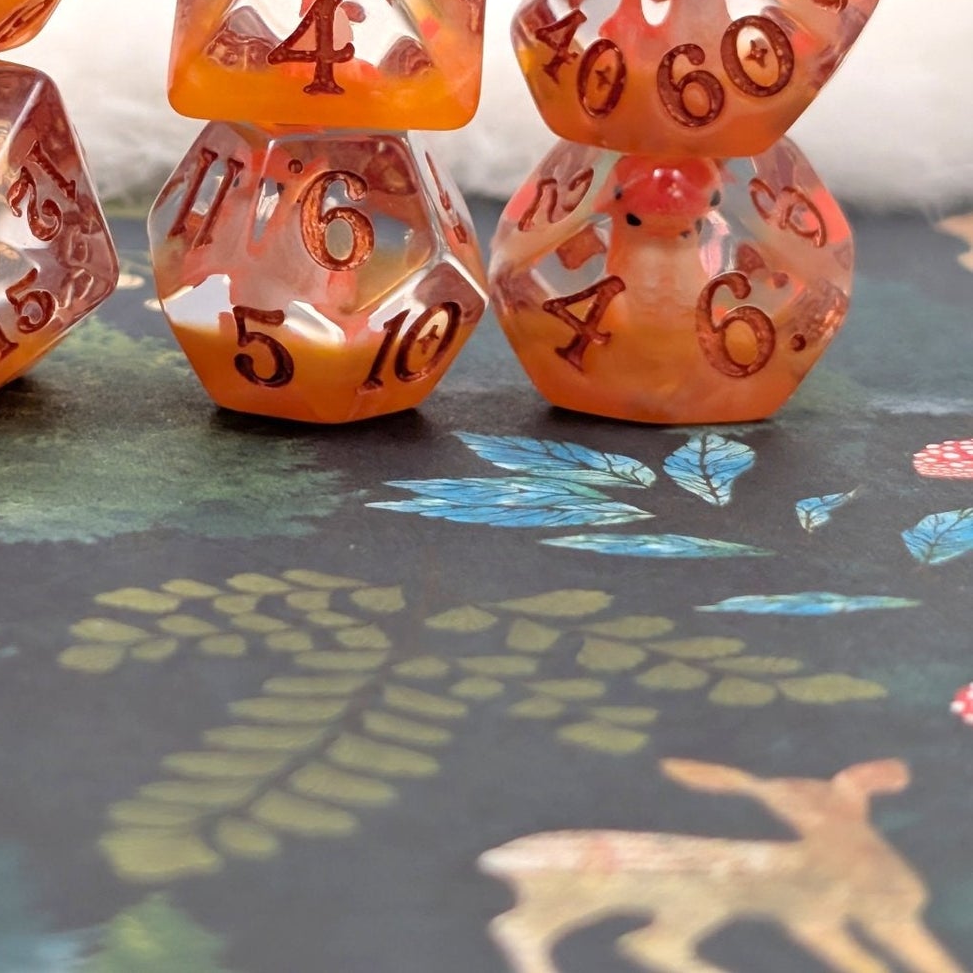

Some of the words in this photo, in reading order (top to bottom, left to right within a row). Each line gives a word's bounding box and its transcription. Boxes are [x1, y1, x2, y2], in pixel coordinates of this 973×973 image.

[656, 14, 795, 128] 60
[233, 304, 295, 388] 5
[355, 301, 461, 395] 10
[542, 274, 626, 372] 4
